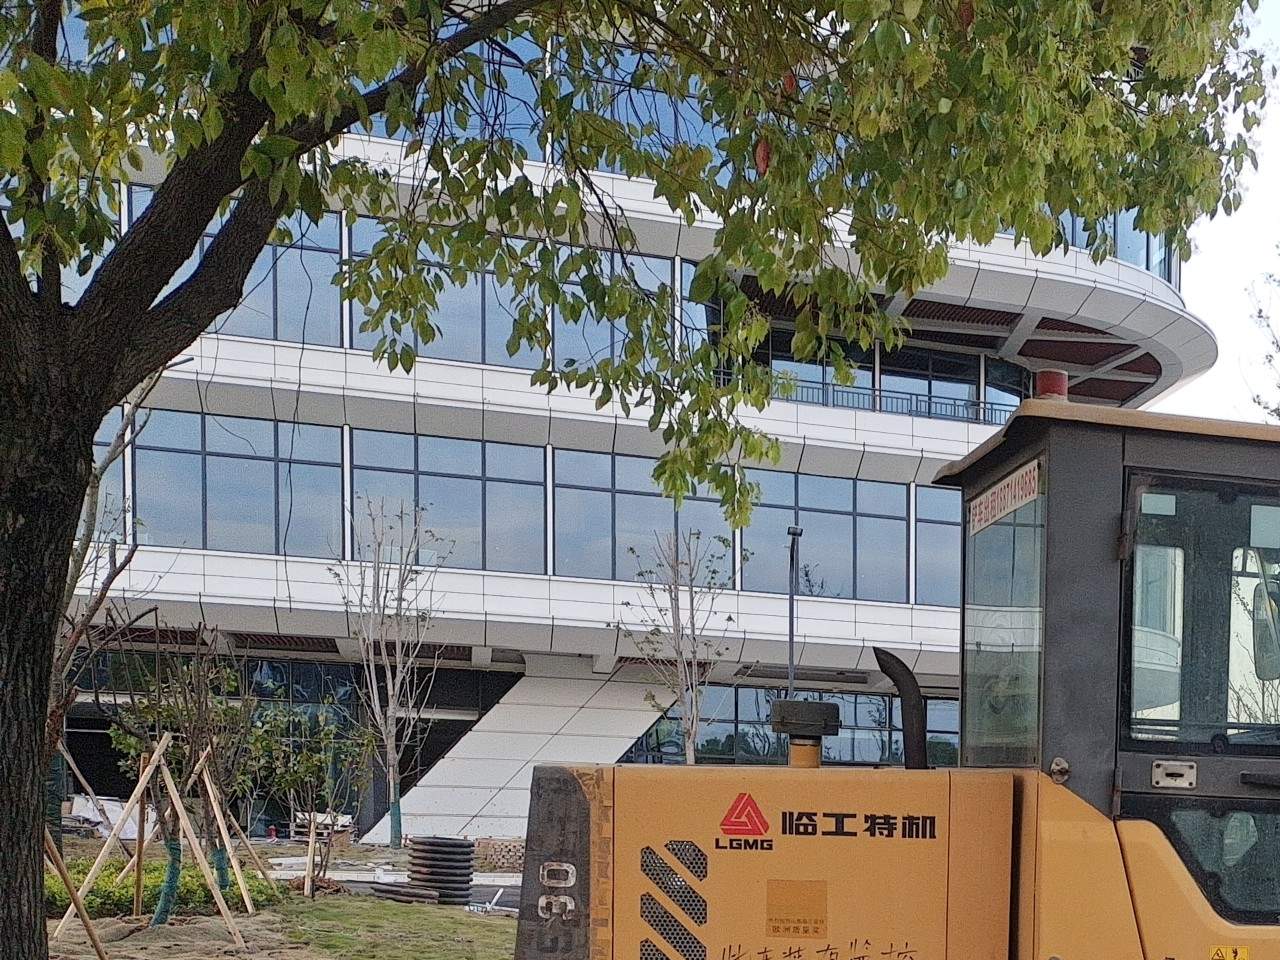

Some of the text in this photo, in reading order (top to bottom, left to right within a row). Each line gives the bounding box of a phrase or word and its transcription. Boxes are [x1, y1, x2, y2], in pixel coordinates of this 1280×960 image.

[781, 811, 937, 840] 临工特机
[714, 838, 774, 851] LGMG
